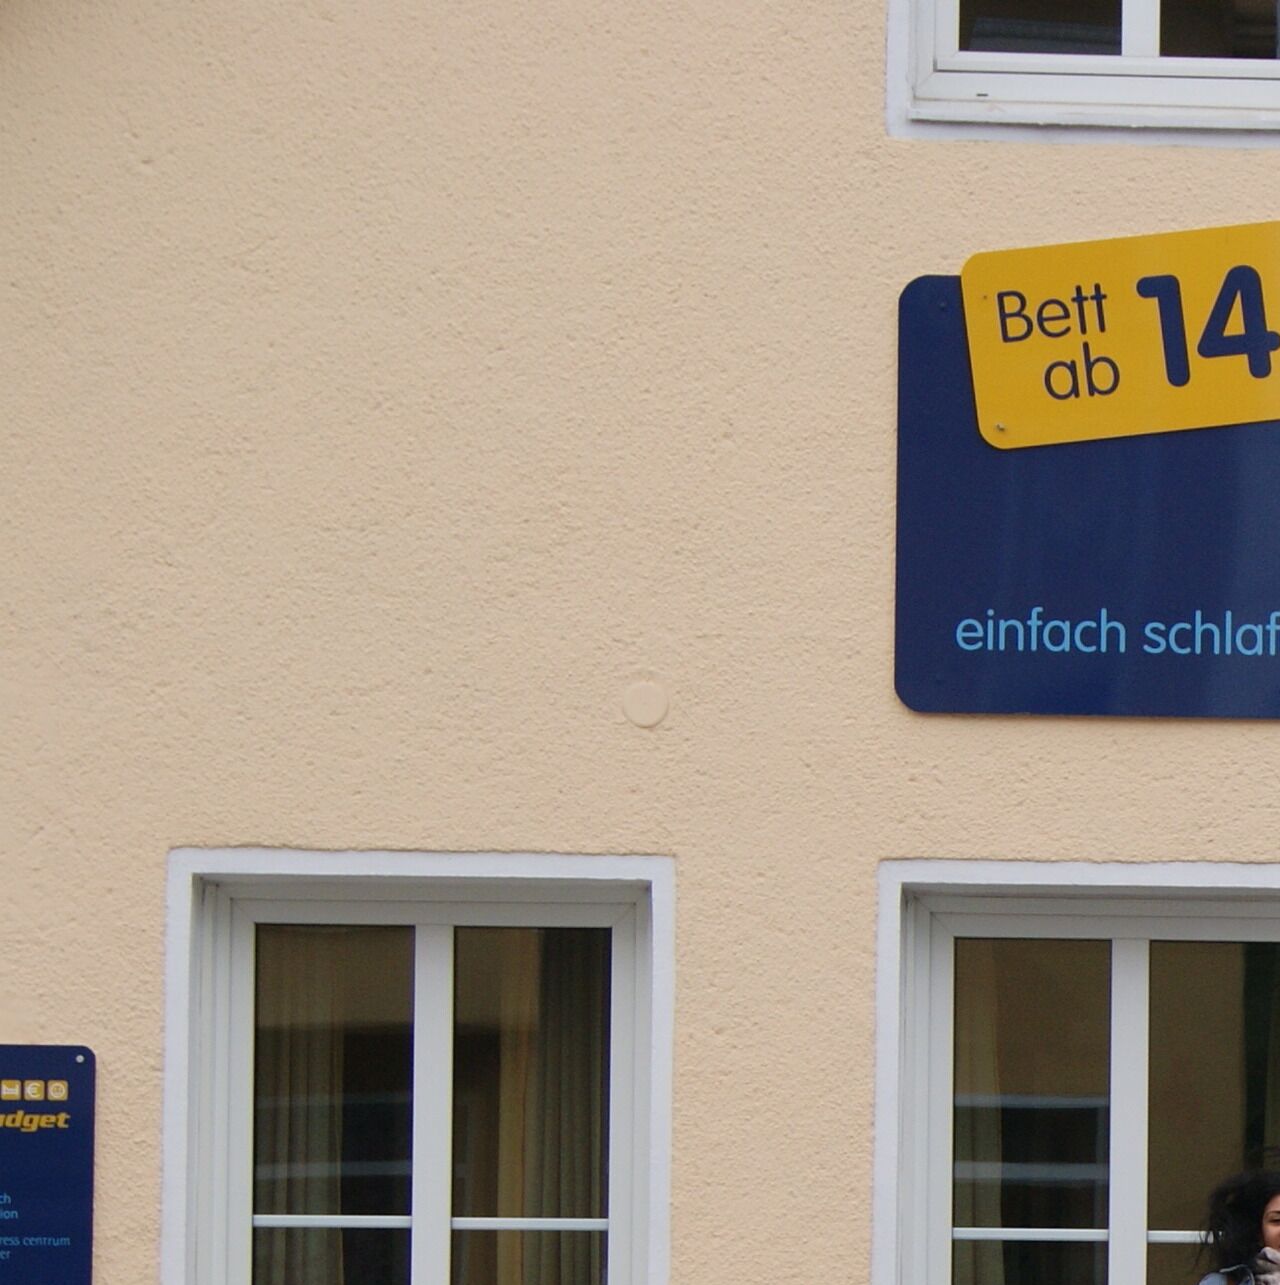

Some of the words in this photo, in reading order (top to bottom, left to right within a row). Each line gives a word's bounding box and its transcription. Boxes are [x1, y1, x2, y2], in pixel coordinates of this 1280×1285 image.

[997, 282, 1108, 344] Bett
[1043, 341, 1121, 401] ab
[955, 605, 1127, 654] einfach
